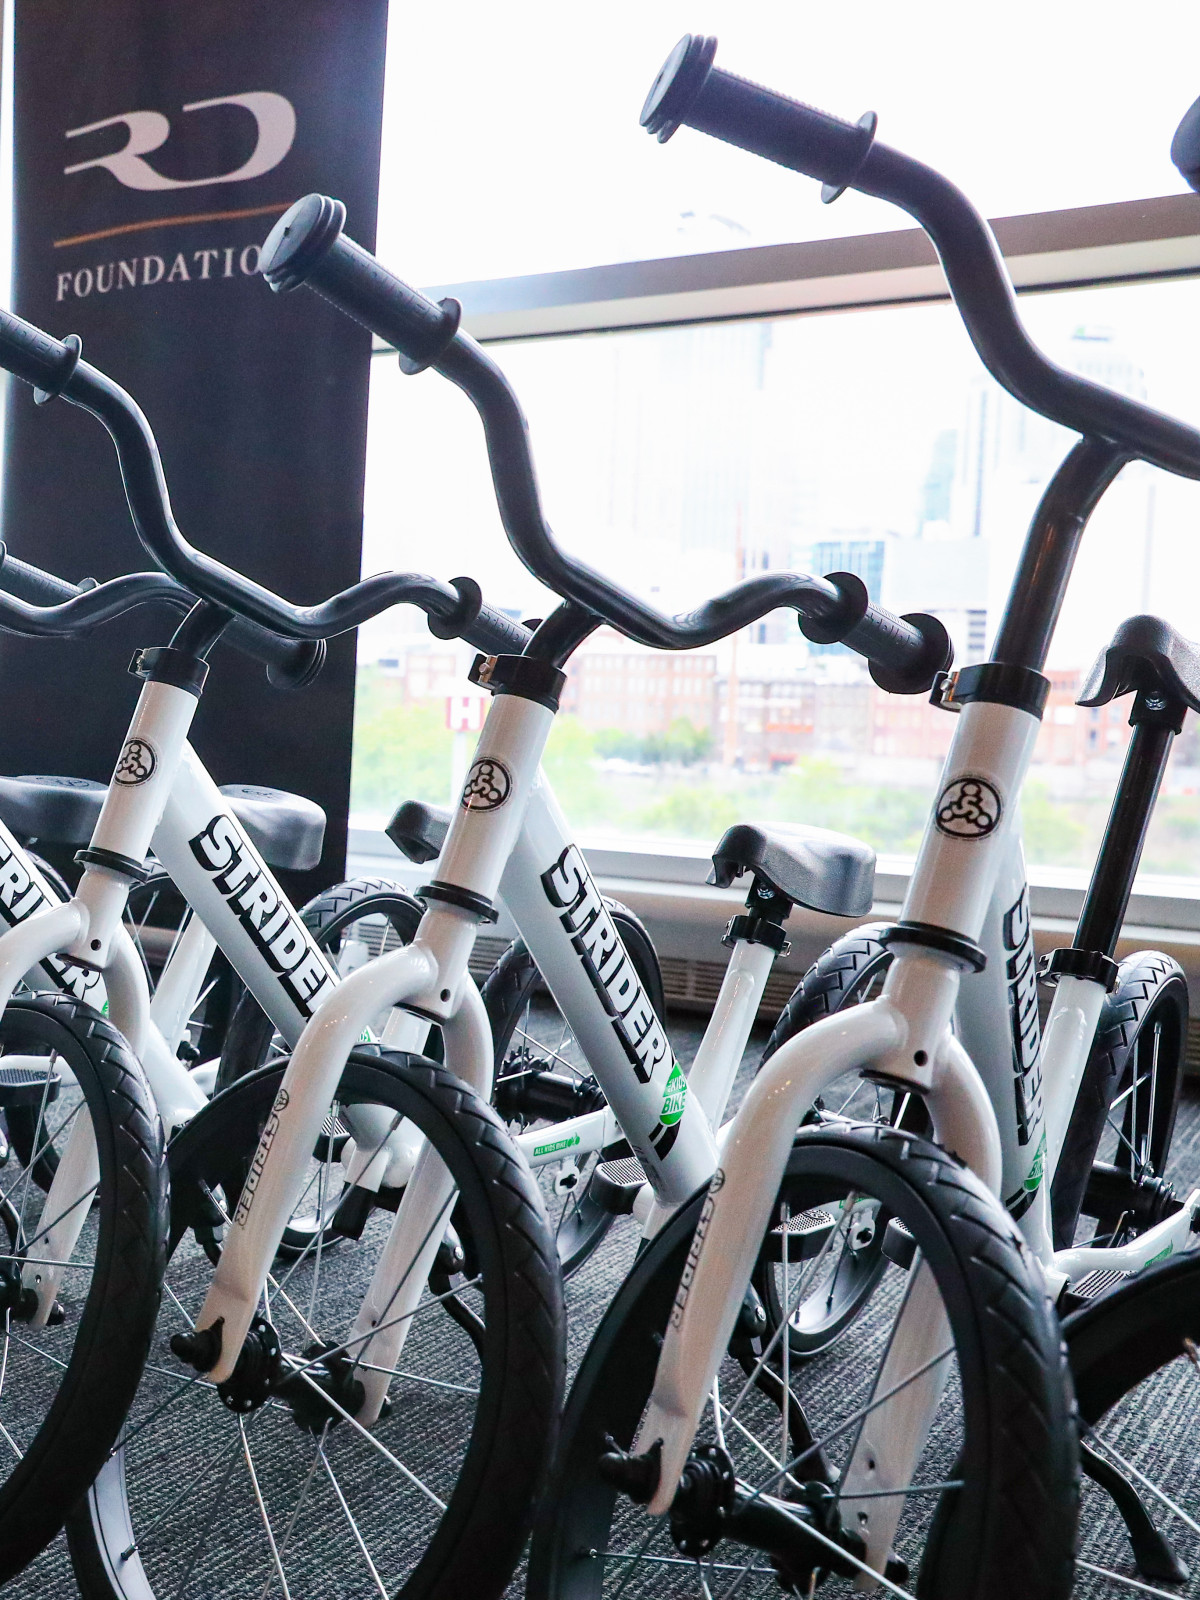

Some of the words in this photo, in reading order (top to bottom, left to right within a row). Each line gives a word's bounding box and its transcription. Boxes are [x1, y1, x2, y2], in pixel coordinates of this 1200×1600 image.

[55, 244, 262, 302] FOUNDATIO
[541, 843, 674, 1084] STRIDER
[661, 1092, 686, 1114] BIKE
[233, 1112, 280, 1226] STRIDER
